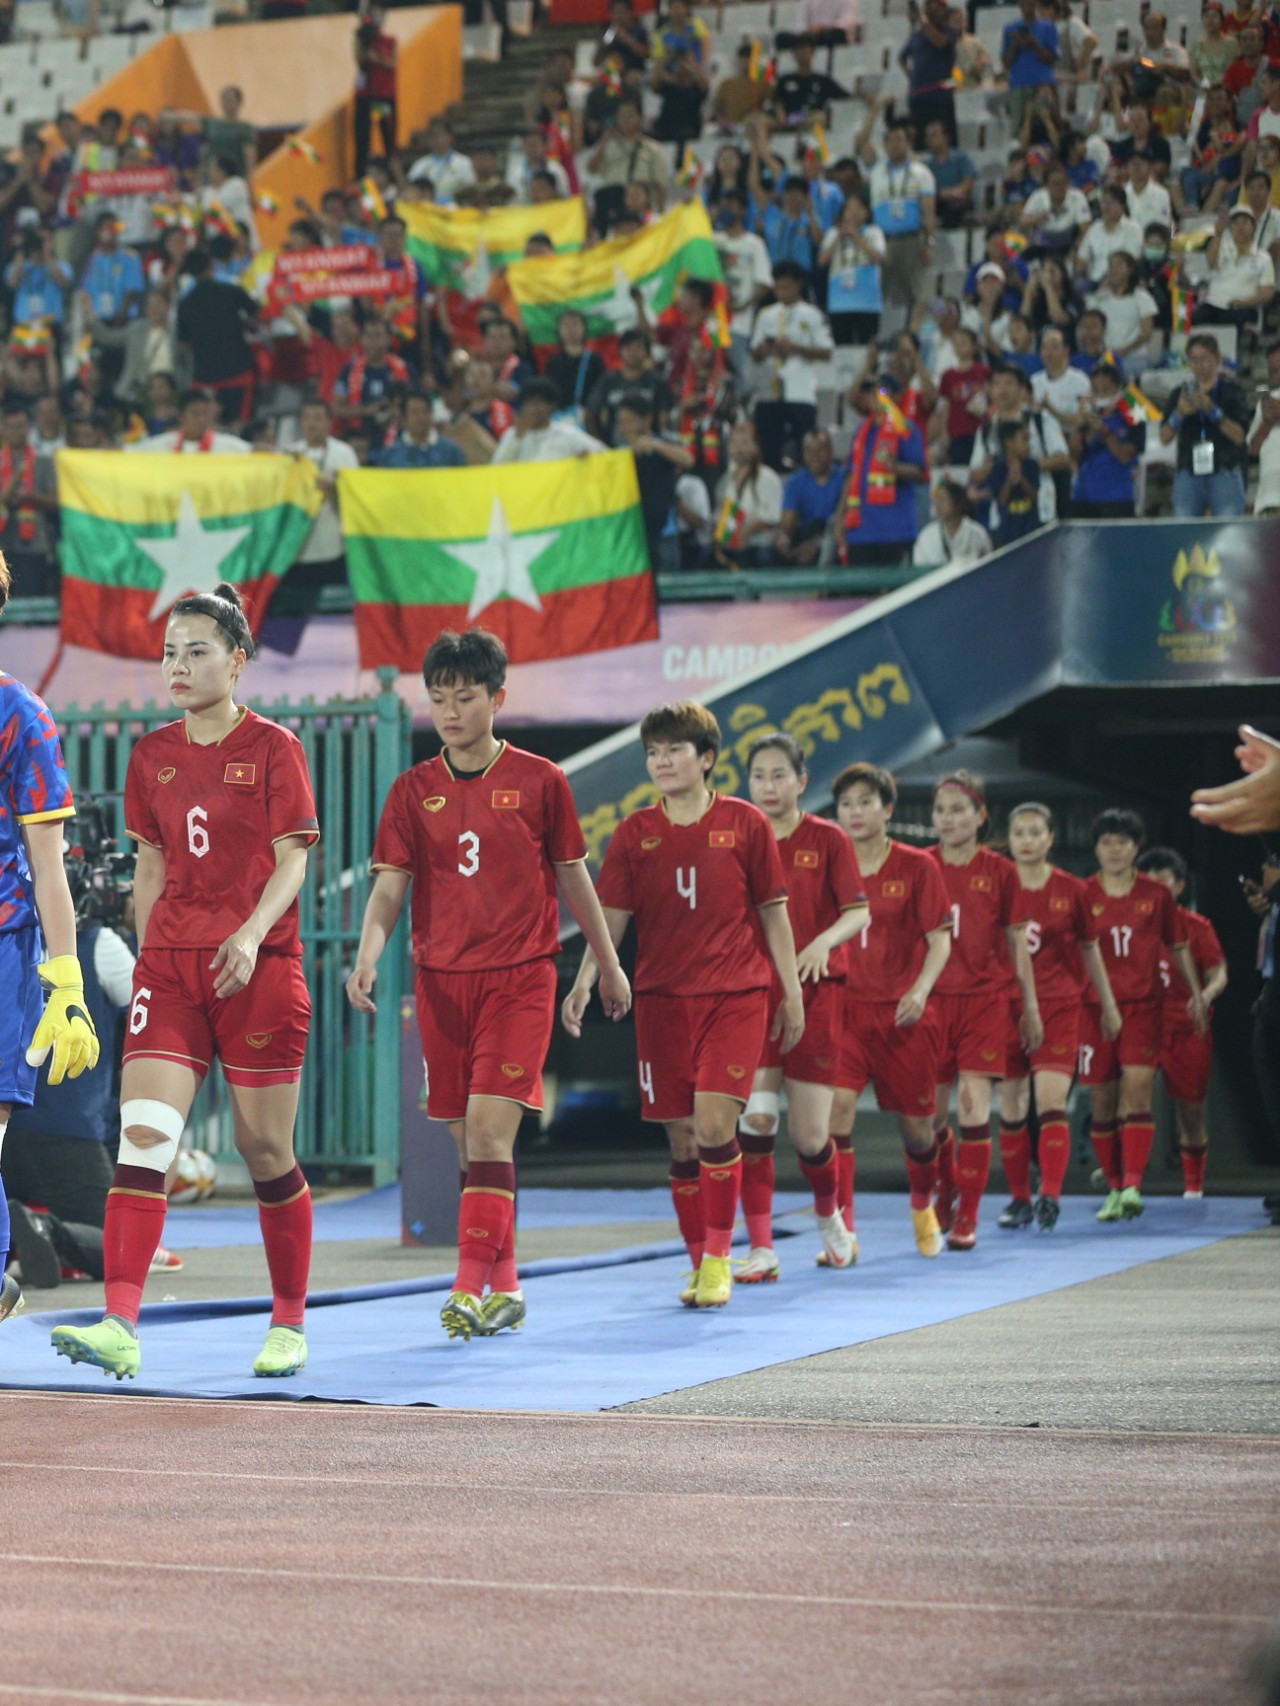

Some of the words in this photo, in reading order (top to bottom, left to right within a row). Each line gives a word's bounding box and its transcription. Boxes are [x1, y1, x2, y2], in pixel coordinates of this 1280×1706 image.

[186, 805, 210, 858] 6
[458, 830, 480, 877] 3
[676, 866, 697, 910] 4
[1110, 925, 1133, 957] 17
[129, 987, 152, 1035] 6
[638, 1060, 655, 1104] 4
